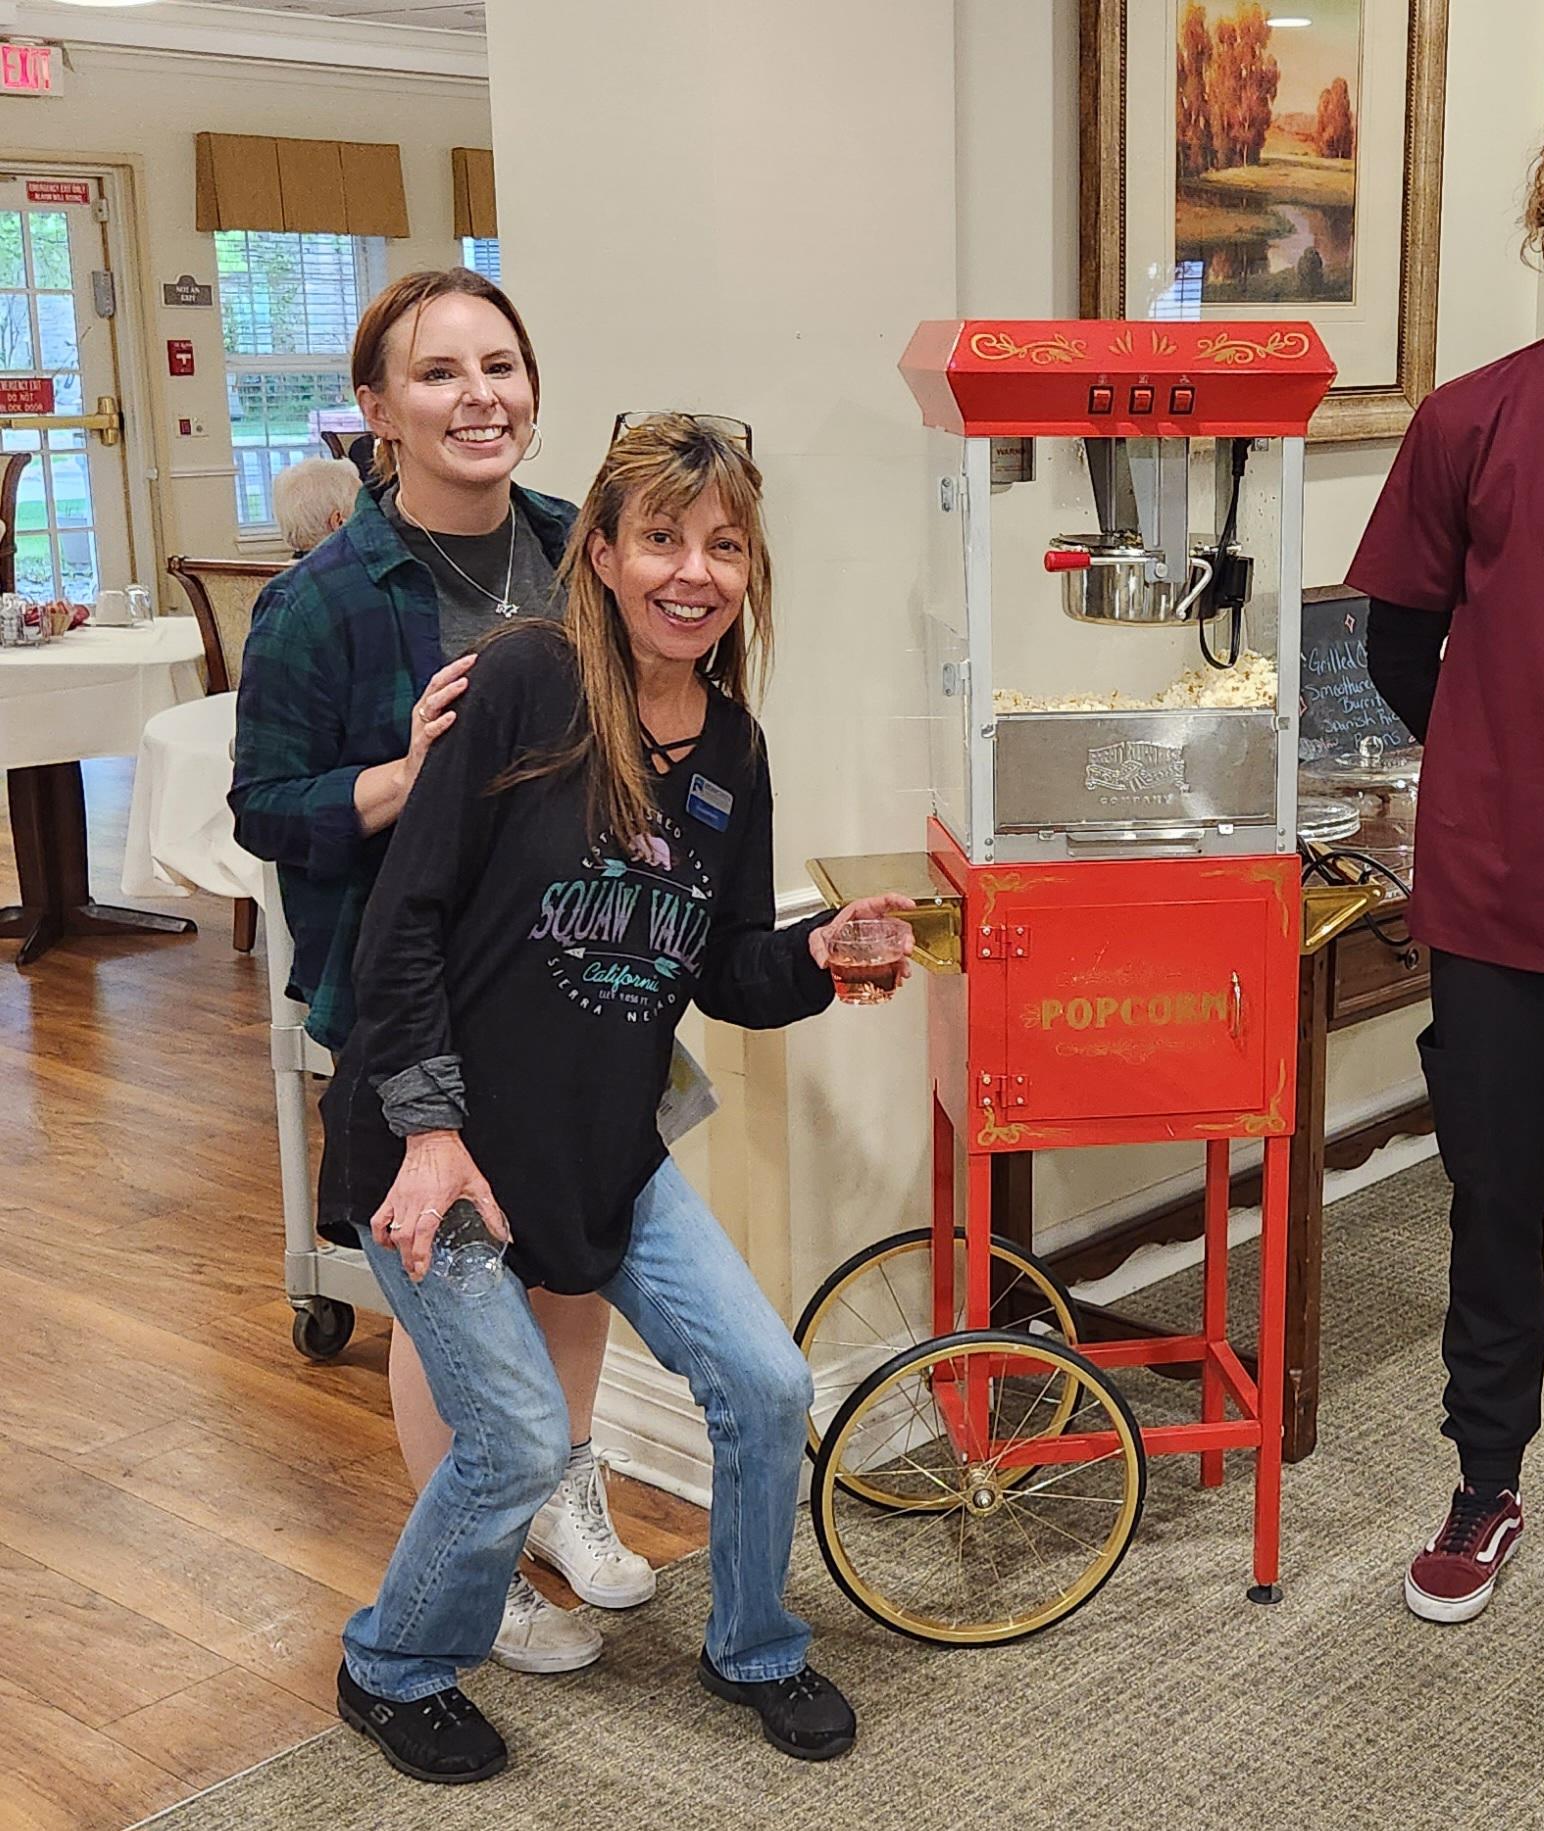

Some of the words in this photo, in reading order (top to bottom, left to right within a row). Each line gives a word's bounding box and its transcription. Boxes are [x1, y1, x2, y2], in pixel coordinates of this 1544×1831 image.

[2, 46, 51, 89] EXIT
[1308, 641, 1358, 675] Grilled
[1338, 692, 1384, 714] Burrit
[1377, 708, 1401, 725] Ric
[528, 880, 643, 947] SQUAW
[547, 958, 603, 1015] SIERRA
[1041, 990, 1228, 1031] POPCORN
